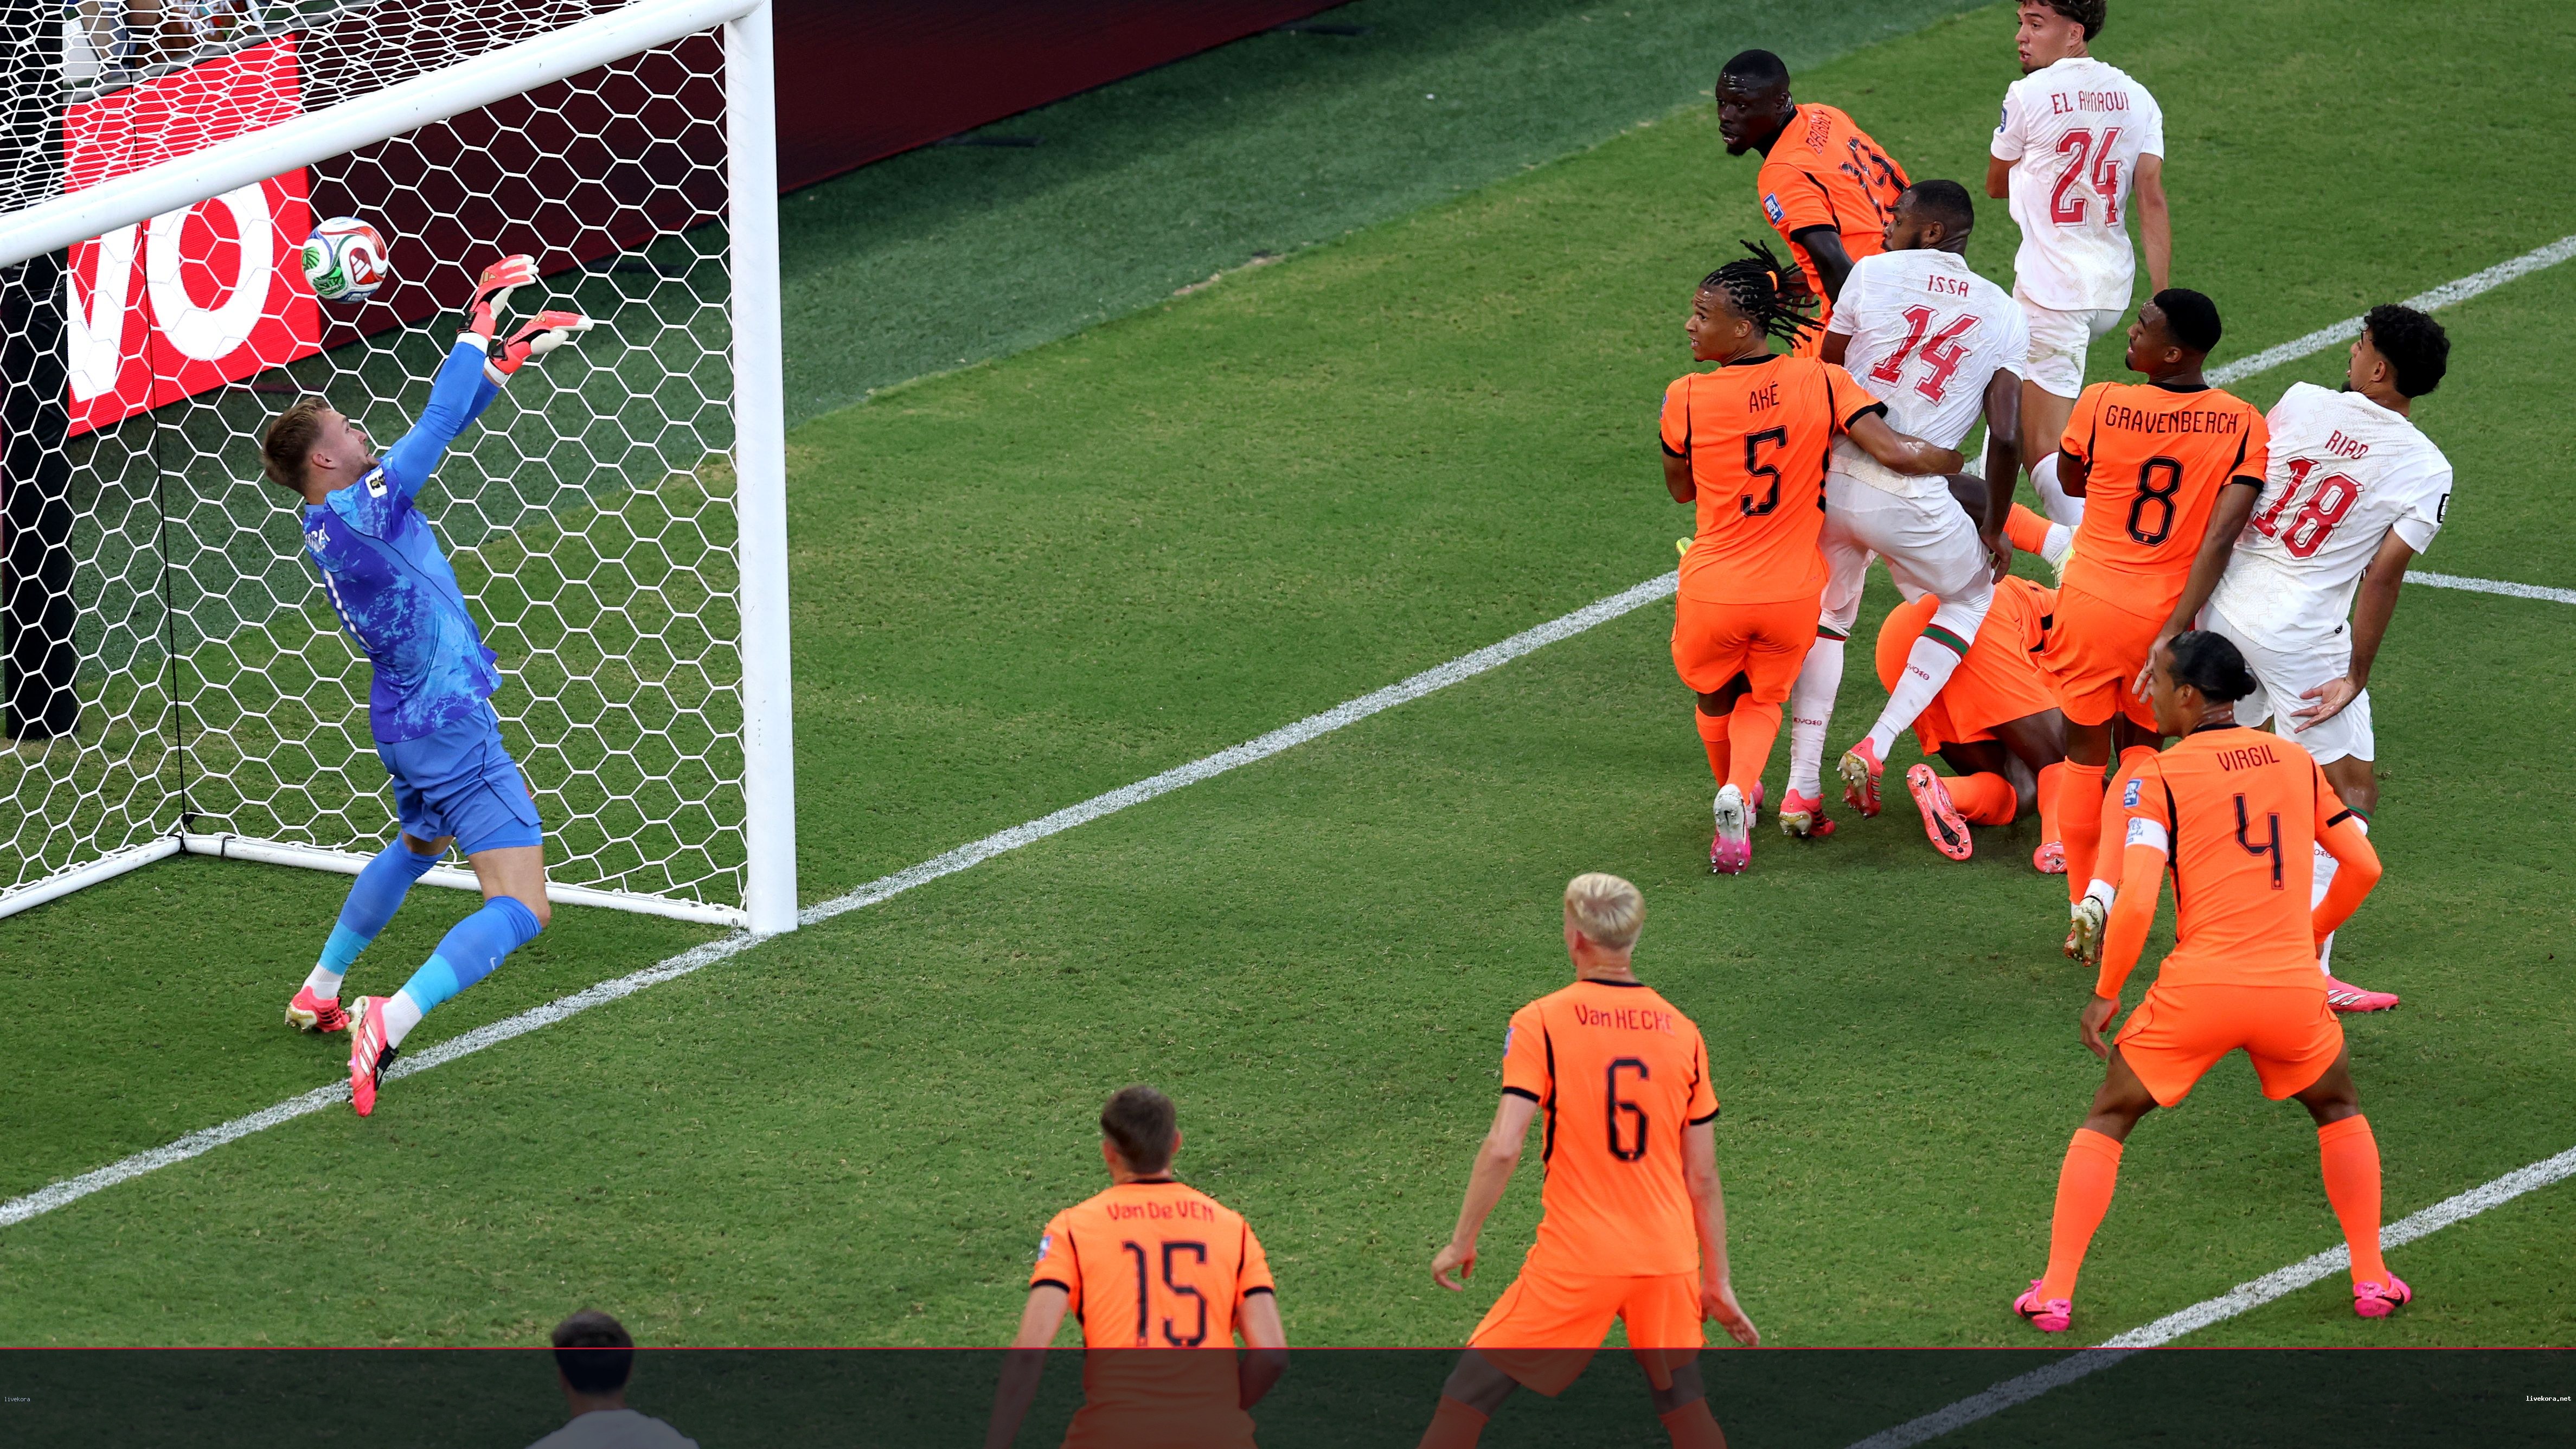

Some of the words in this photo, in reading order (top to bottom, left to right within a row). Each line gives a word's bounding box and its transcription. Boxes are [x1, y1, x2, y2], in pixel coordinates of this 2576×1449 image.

[2051, 93, 2074, 114] EL
[2078, 91, 2130, 112] AYNAOUI
[2050, 127, 2123, 228] 24
[1928, 274, 1969, 297] ISSA
[1749, 381, 1780, 413] AKÉ
[1868, 304, 1982, 407] 14
[2105, 405, 2239, 434] GRAVENBERCH
[2324, 430, 2369, 460] RIAD
[1740, 425, 1788, 517] 5
[2125, 456, 2184, 547] 8
[2252, 456, 2364, 560] 18
[2217, 745, 2280, 771] VIRGIL
[2233, 793, 2284, 890] 4
[1605, 1056, 1650, 1163] 6
[1122, 1240, 1207, 1348] 15
